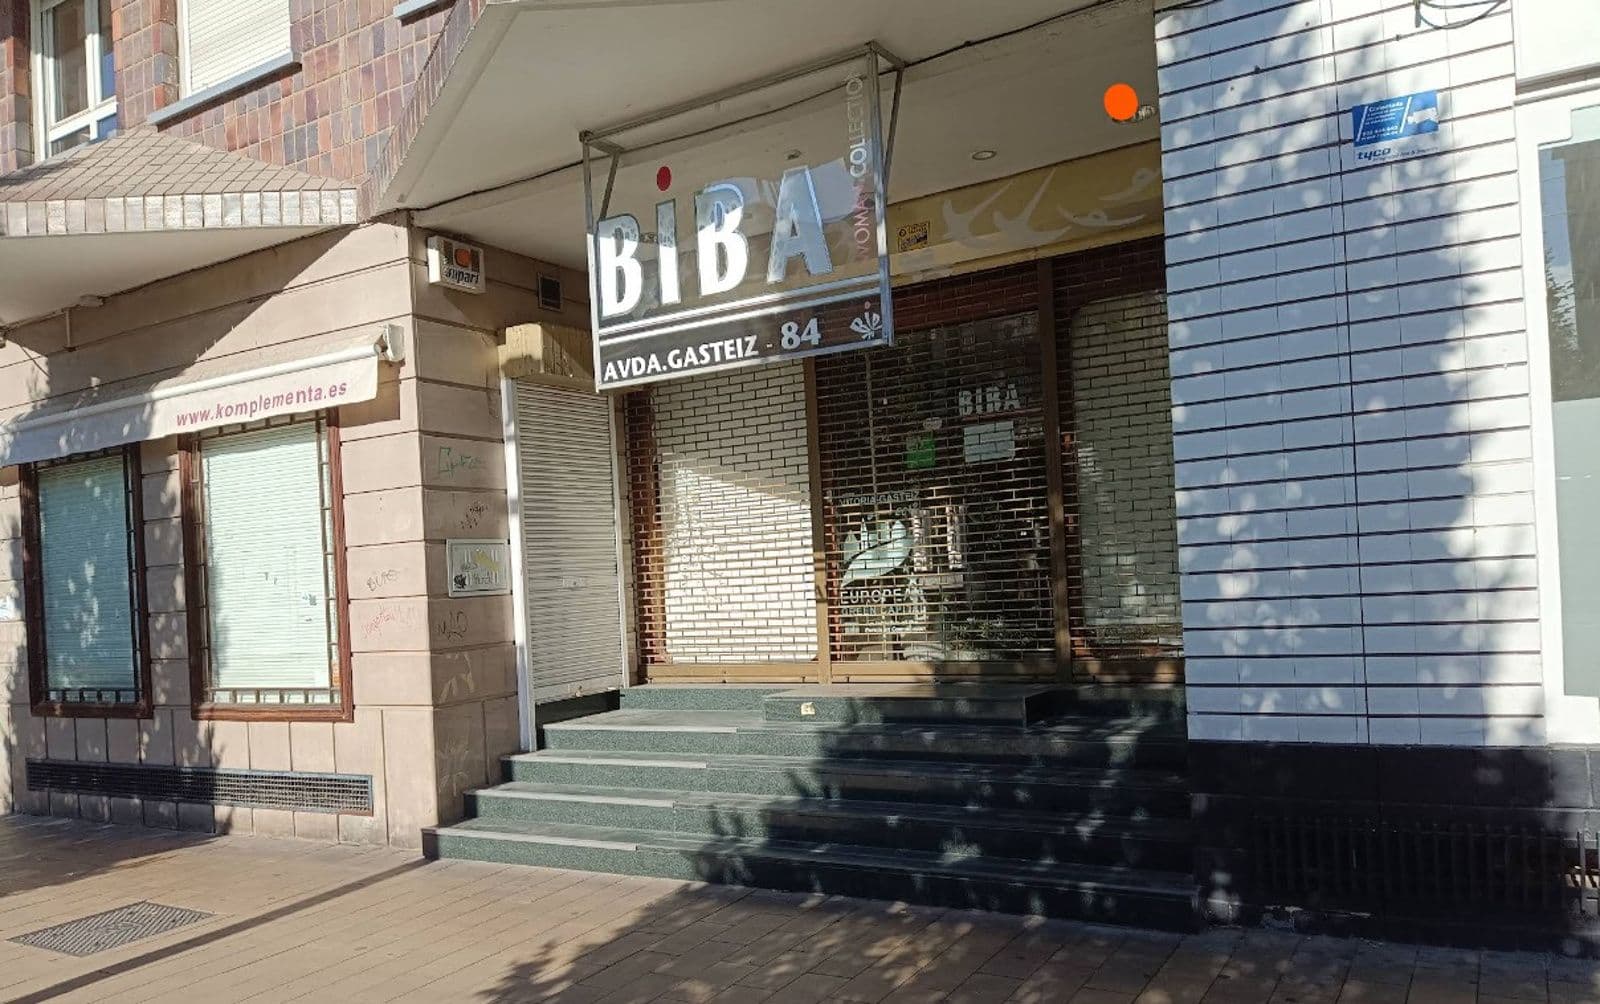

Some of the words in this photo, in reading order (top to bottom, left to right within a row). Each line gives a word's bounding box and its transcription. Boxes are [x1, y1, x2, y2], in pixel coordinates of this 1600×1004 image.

[1357, 147, 1391, 161] tyco
[780, 318, 822, 350] 84
[176, 382, 348, 426] www.komplementa.es
